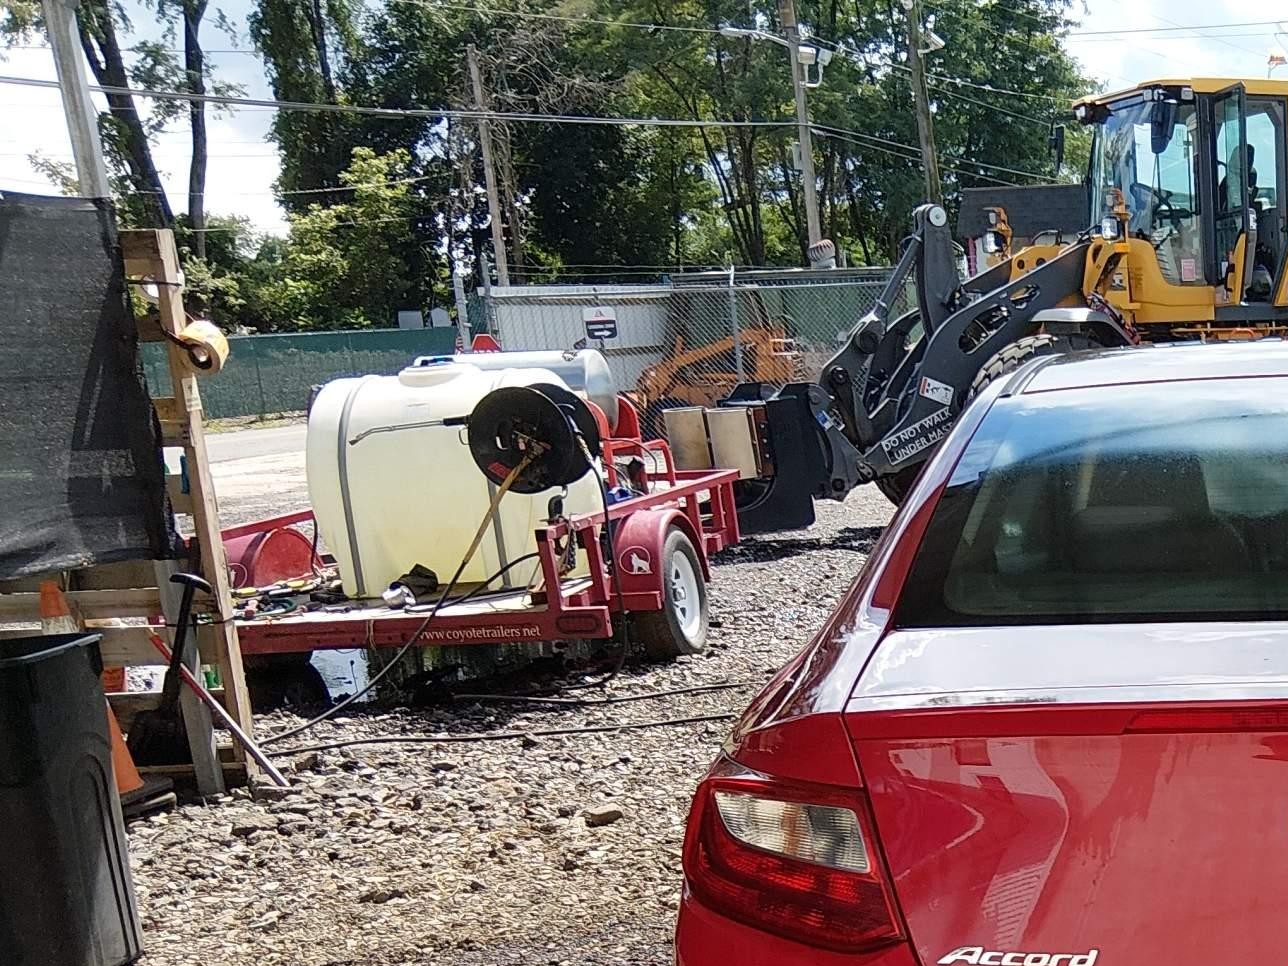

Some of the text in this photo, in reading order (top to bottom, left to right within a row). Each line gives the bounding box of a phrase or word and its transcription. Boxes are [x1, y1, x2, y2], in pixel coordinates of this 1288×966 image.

[882, 408, 953, 452] DO NOT WALK
[893, 437, 929, 460] UNDER
